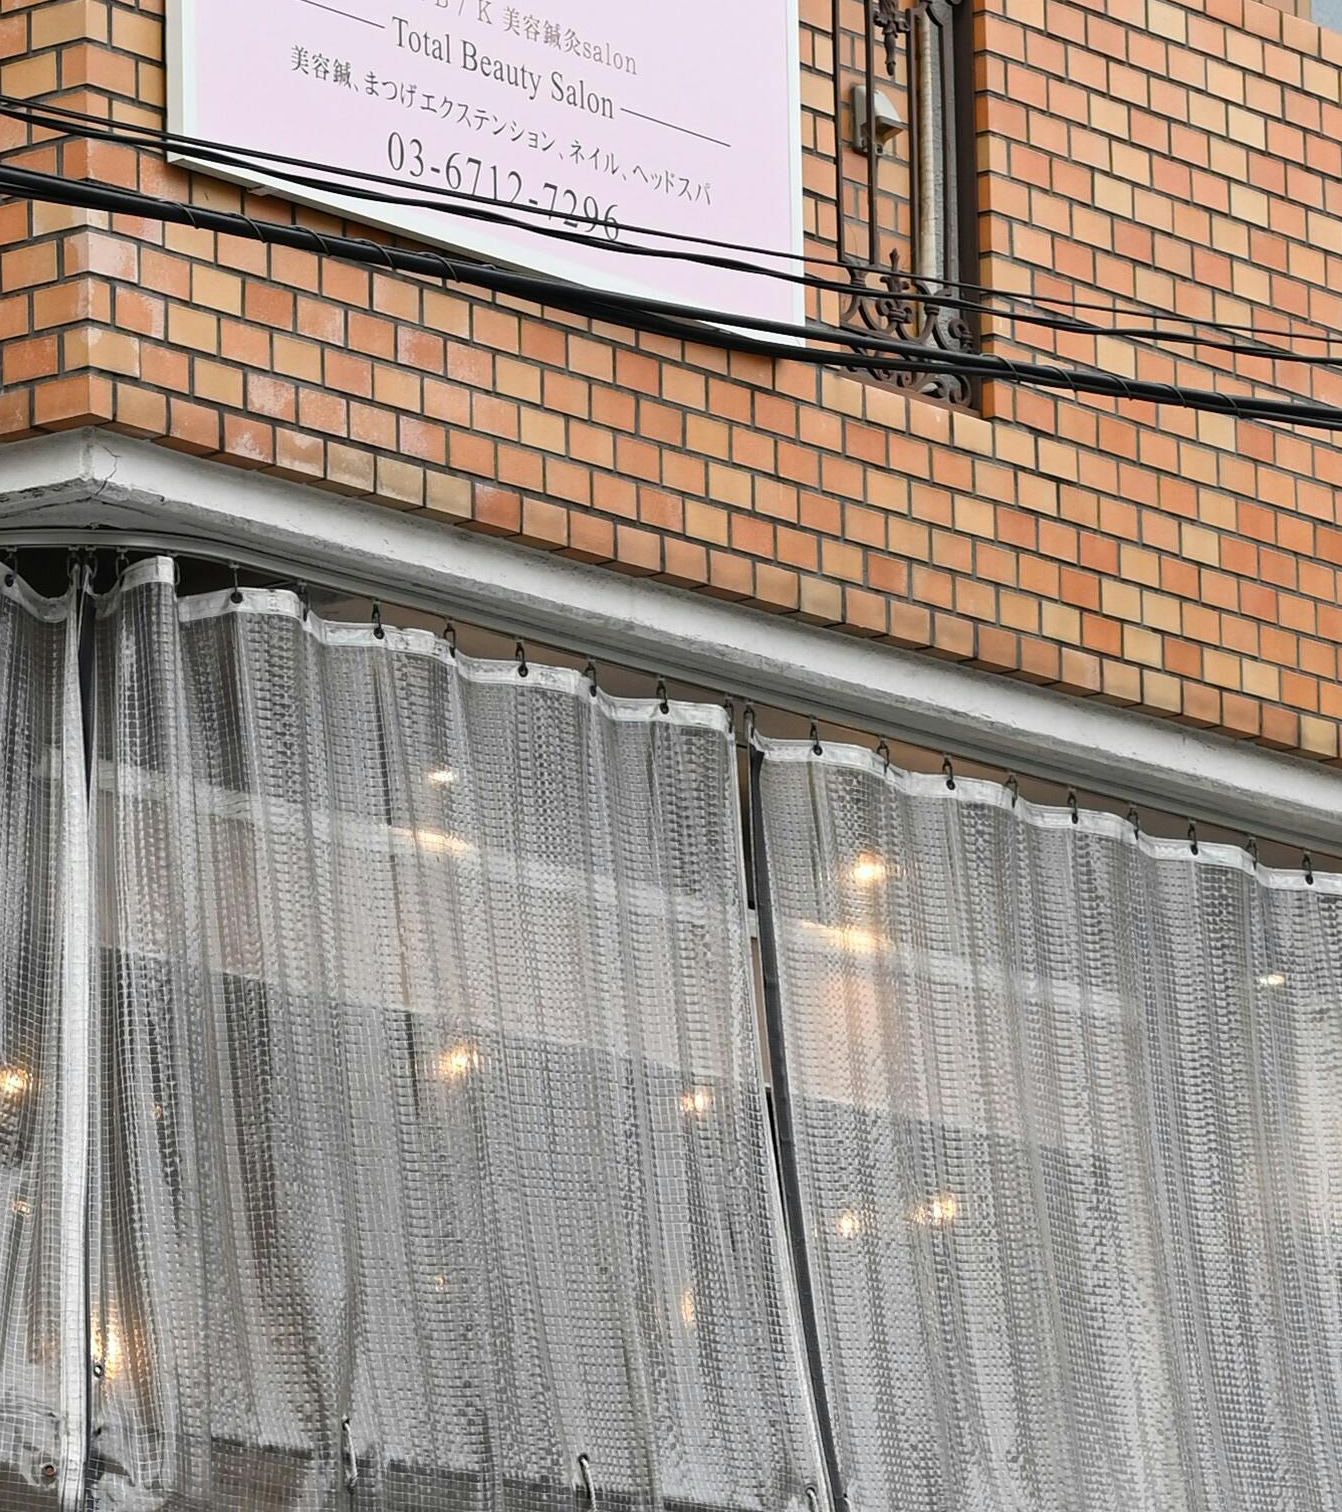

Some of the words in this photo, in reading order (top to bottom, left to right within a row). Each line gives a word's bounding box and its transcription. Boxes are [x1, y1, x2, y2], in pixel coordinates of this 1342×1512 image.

[392, 15, 452, 65] Total
[460, 39, 542, 100] Beauty
[550, 71, 615, 120] Salon
